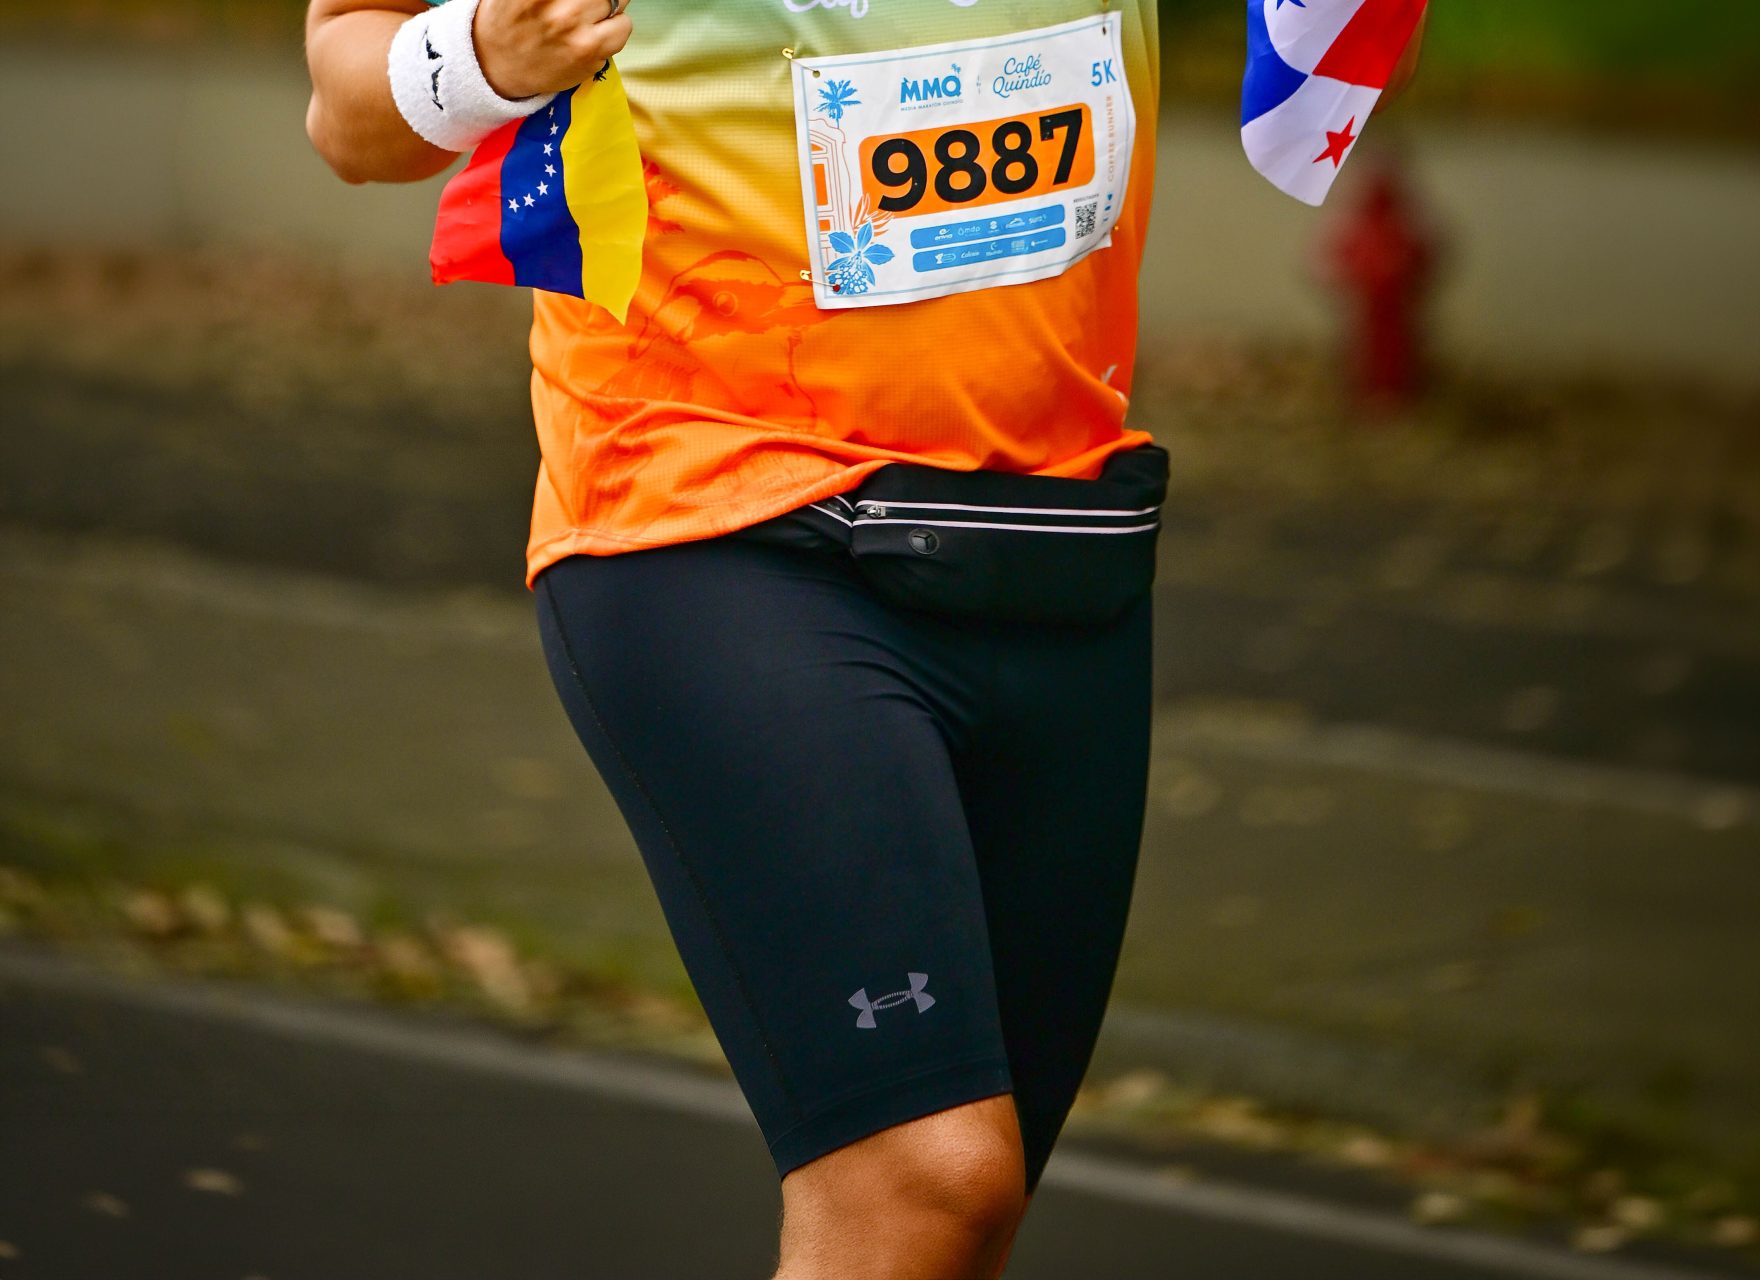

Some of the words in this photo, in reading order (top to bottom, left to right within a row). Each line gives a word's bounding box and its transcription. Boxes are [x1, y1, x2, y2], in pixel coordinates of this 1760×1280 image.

[1004, 53, 1042, 76] Café
[1091, 58, 1117, 88] 5K
[900, 75, 962, 104] MMQ
[992, 70, 1052, 98] Quindío
[872, 108, 1083, 213] 9887
